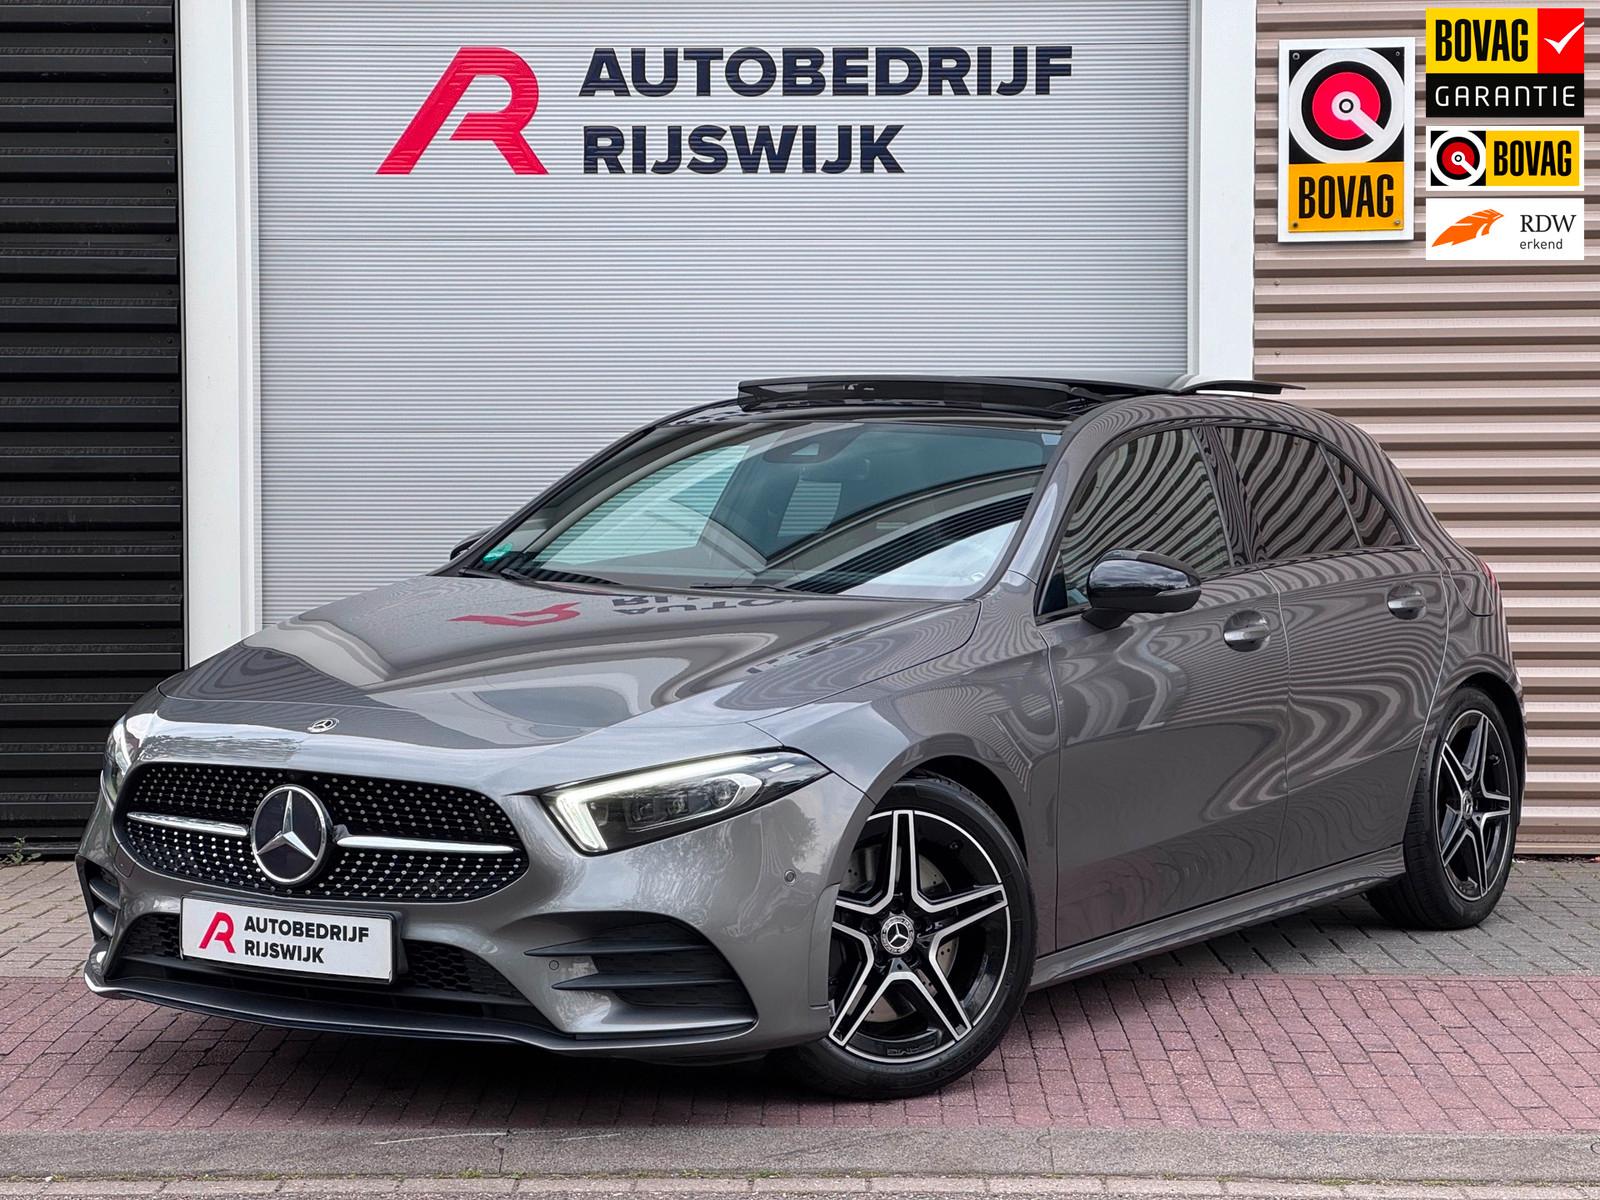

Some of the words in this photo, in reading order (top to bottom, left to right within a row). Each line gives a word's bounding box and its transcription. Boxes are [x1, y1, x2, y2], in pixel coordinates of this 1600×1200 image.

[578, 45, 1073, 97] AUTOBEDRIJF
[582, 124, 906, 174] RIJSWIJK
[1298, 174, 1394, 219] BOVAG
[244, 916, 369, 943] AUTOBEDRIJF
[244, 940, 324, 964] RIJSWIJK
